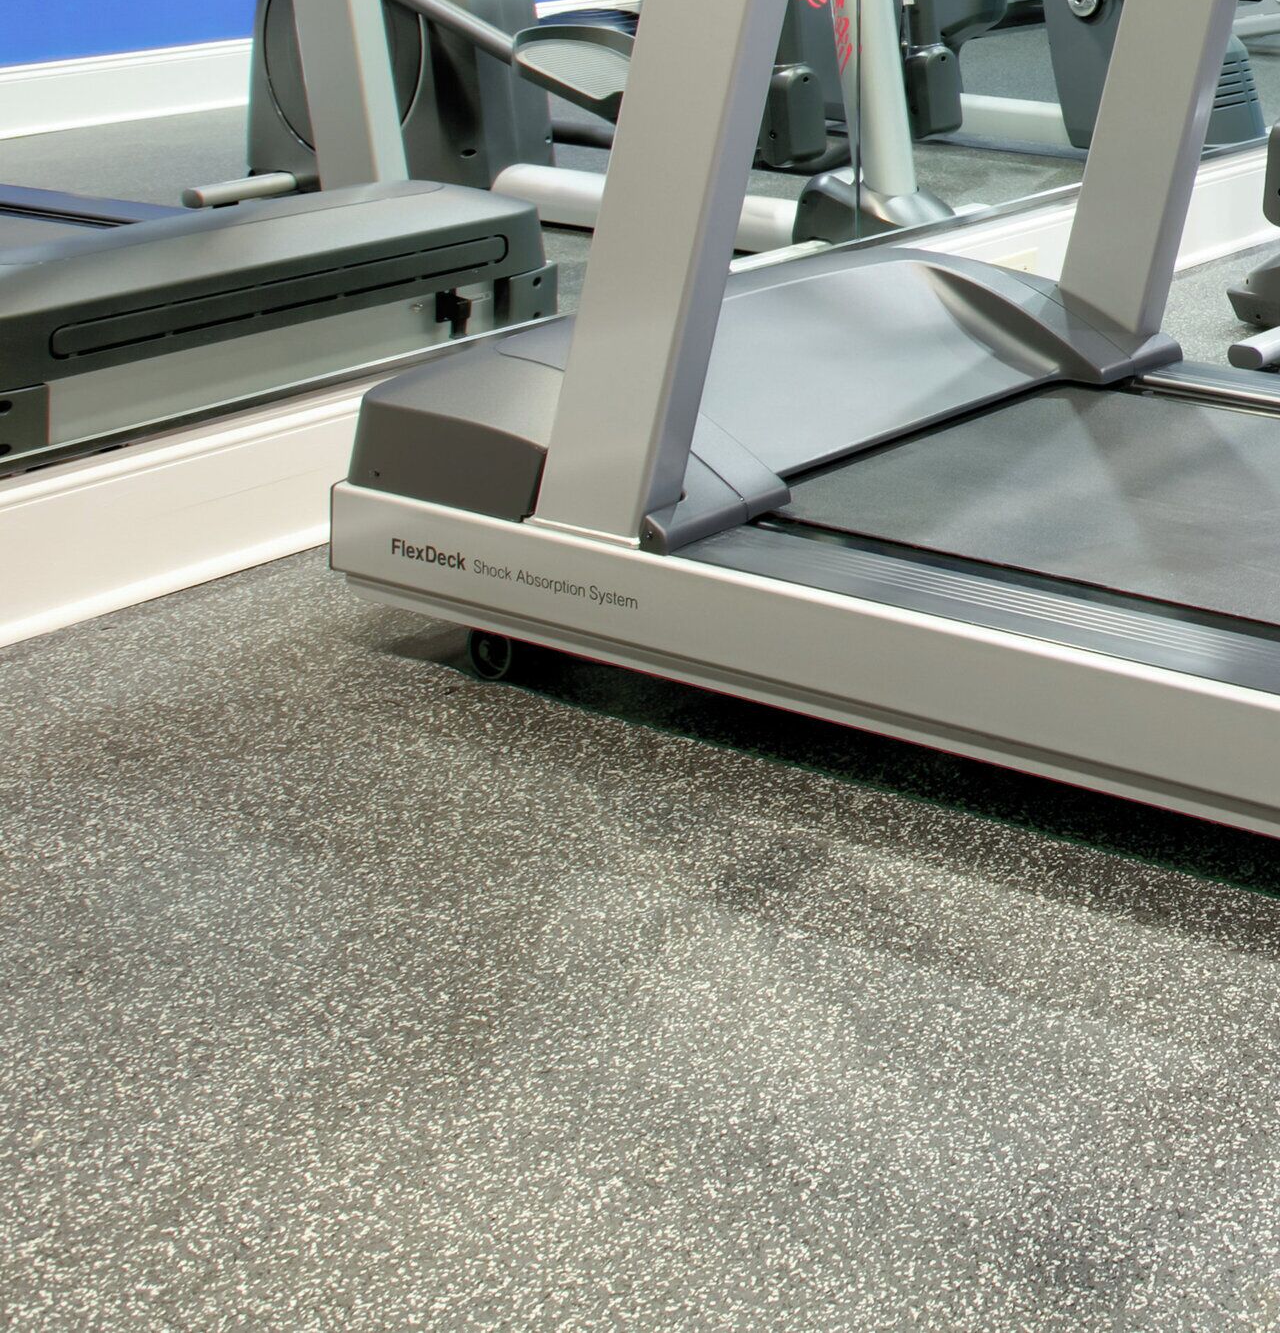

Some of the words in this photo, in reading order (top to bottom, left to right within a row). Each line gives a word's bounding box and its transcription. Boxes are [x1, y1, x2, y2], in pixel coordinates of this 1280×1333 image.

[391, 538, 466, 570] FlexDeck
[473, 559, 512, 581] Shock
[516, 569, 586, 598] Absorption
[589, 585, 638, 610] System
